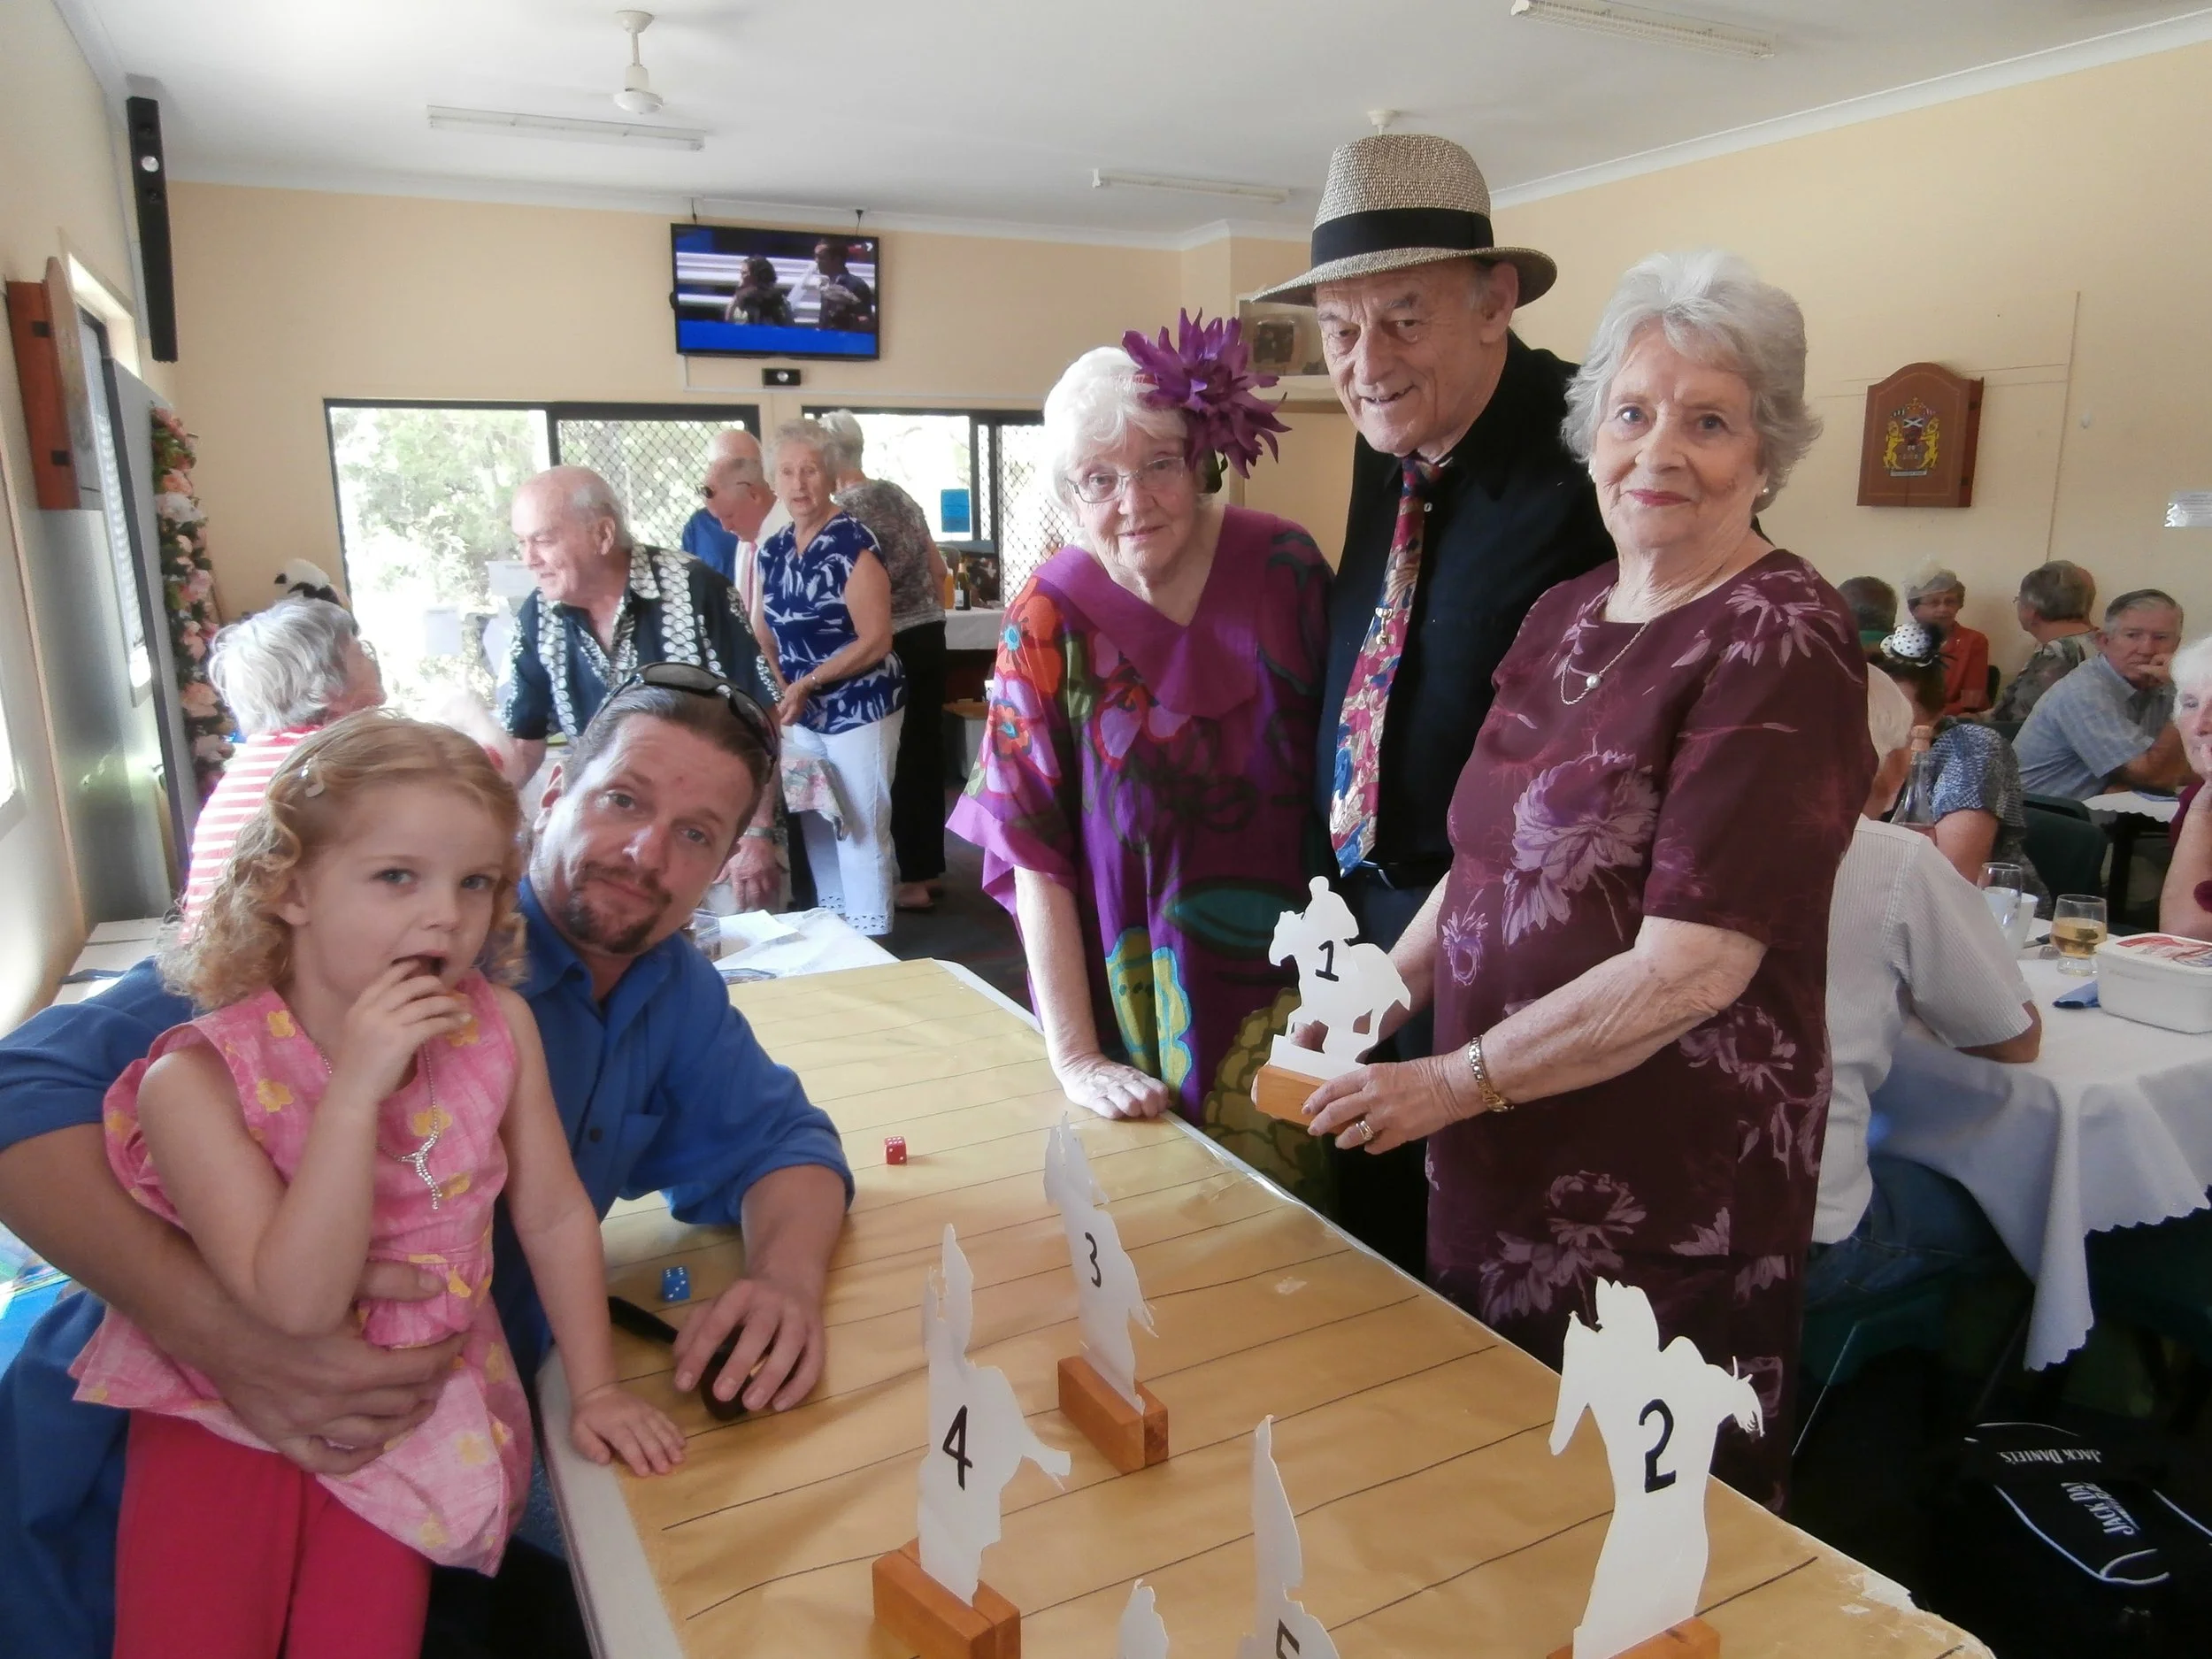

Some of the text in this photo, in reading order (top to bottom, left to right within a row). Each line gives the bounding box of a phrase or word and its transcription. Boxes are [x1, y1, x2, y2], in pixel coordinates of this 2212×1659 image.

[1315, 940, 1339, 982] 1
[1085, 1232, 1102, 1288] 3
[942, 1404, 973, 1491] 4
[1639, 1399, 1676, 1494] 2
[2061, 1448, 2102, 1463] JACK
[2083, 1502, 2134, 1535] JACK
